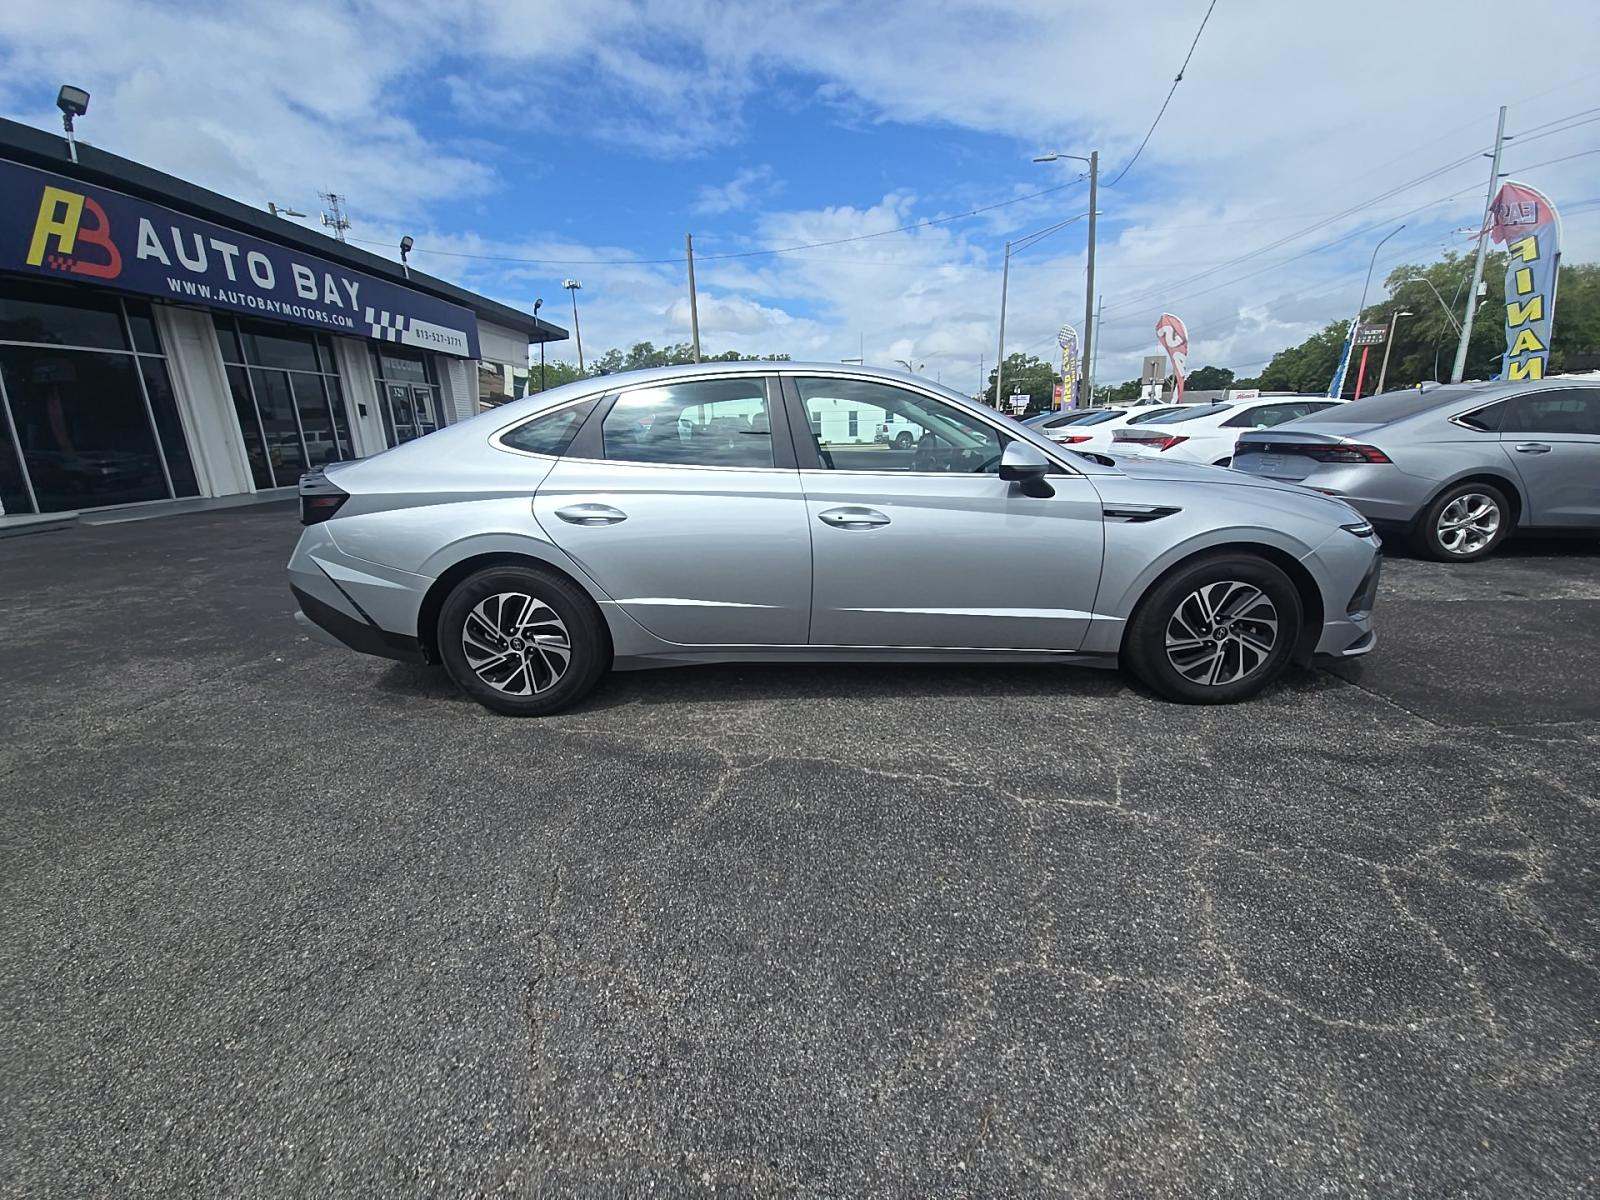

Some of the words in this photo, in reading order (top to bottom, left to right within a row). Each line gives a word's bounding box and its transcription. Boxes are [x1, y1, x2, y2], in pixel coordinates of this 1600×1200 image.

[137, 217, 276, 290] AUTO
[291, 262, 360, 312] BAY
[166, 277, 354, 329] WWW.AUTOBAYMOTORS.COM
